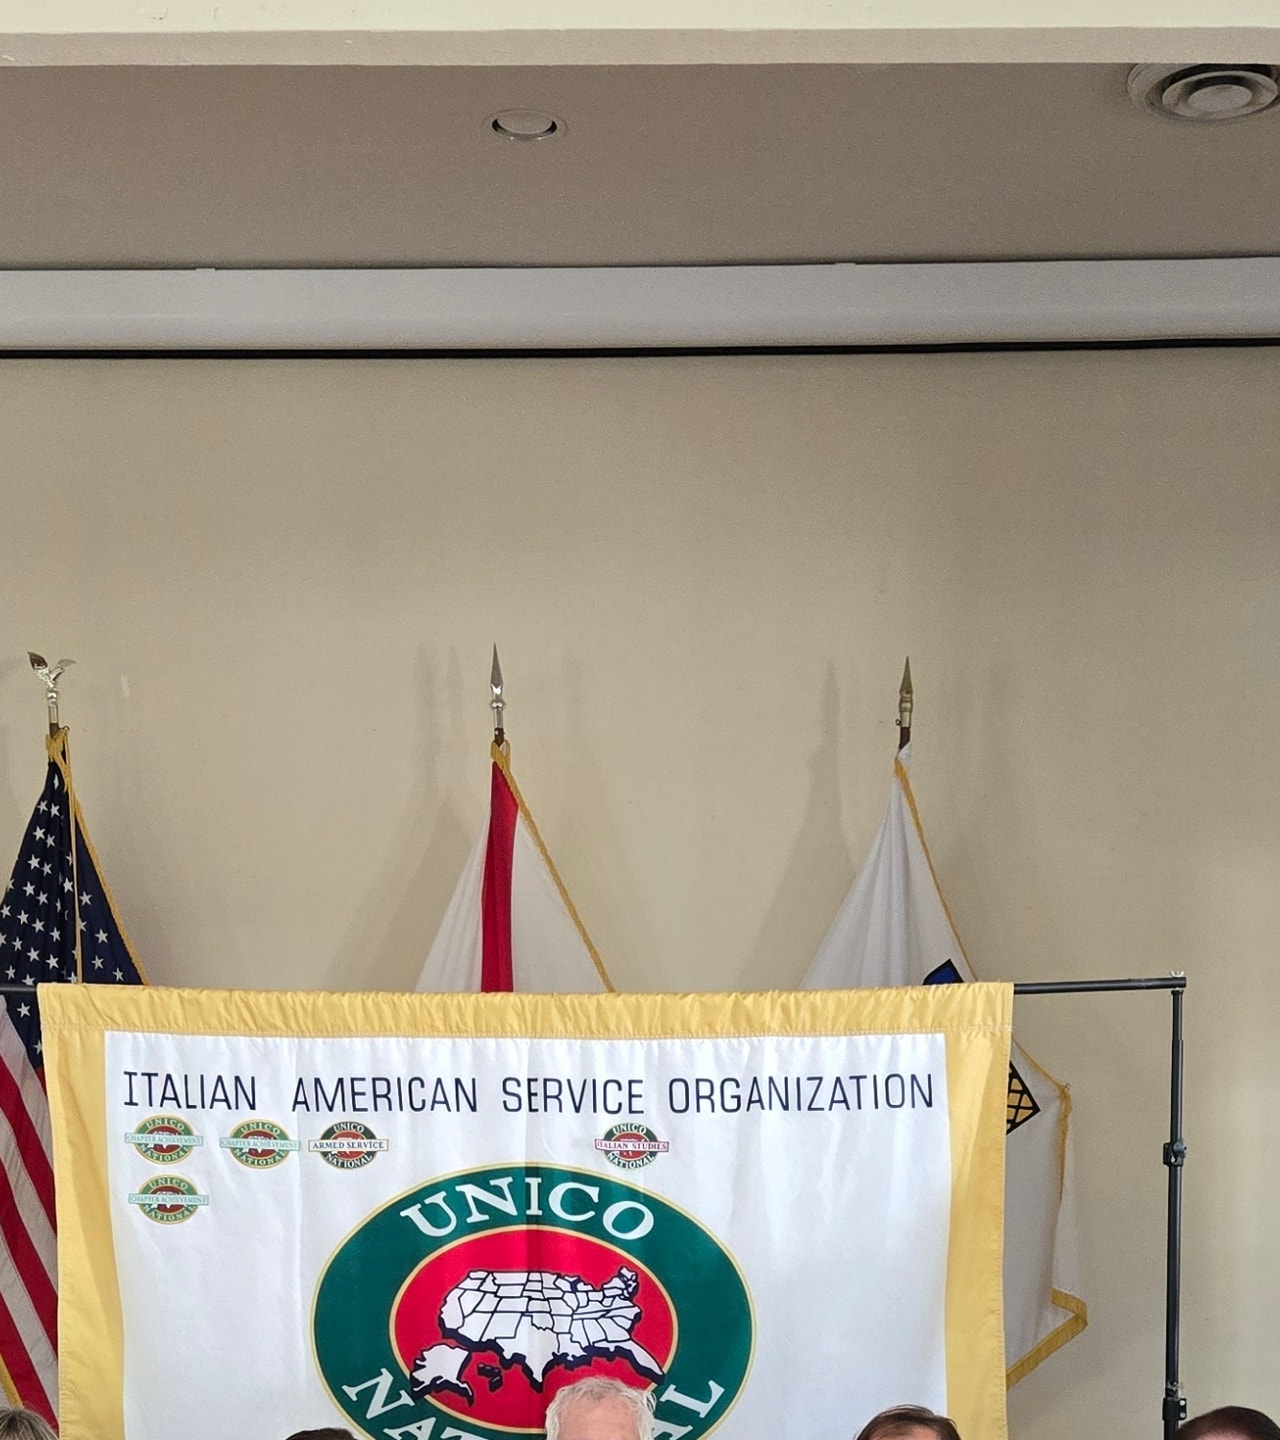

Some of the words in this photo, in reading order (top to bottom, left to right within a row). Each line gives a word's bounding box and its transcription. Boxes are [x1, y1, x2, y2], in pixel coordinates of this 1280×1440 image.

[123, 1070, 256, 1111] ITALIAN
[291, 1076, 478, 1113] AMERICAN
[501, 1076, 645, 1115] SERVICE
[669, 1072, 934, 1114] ORGANIZATION
[145, 1117, 185, 1131] UNICO
[241, 1122, 281, 1135] UNICO
[333, 1122, 365, 1133] UNICO
[612, 1123, 647, 1135] UNICO
[312, 1141, 345, 1149] ARMED
[346, 1141, 385, 1149] SERVICE
[596, 1141, 629, 1149] ITALIAN
[631, 1142, 668, 1150] STUDIES
[139, 1144, 190, 1162] NATIONAL
[233, 1148, 287, 1166] NATIONAL
[607, 1152, 656, 1169] NATIONAL
[325, 1153, 373, 1169] NATIONAL
[148, 1177, 188, 1190] UNICO
[144, 1204, 196, 1221] NATIONAL
[399, 1176, 655, 1241] UNICO
